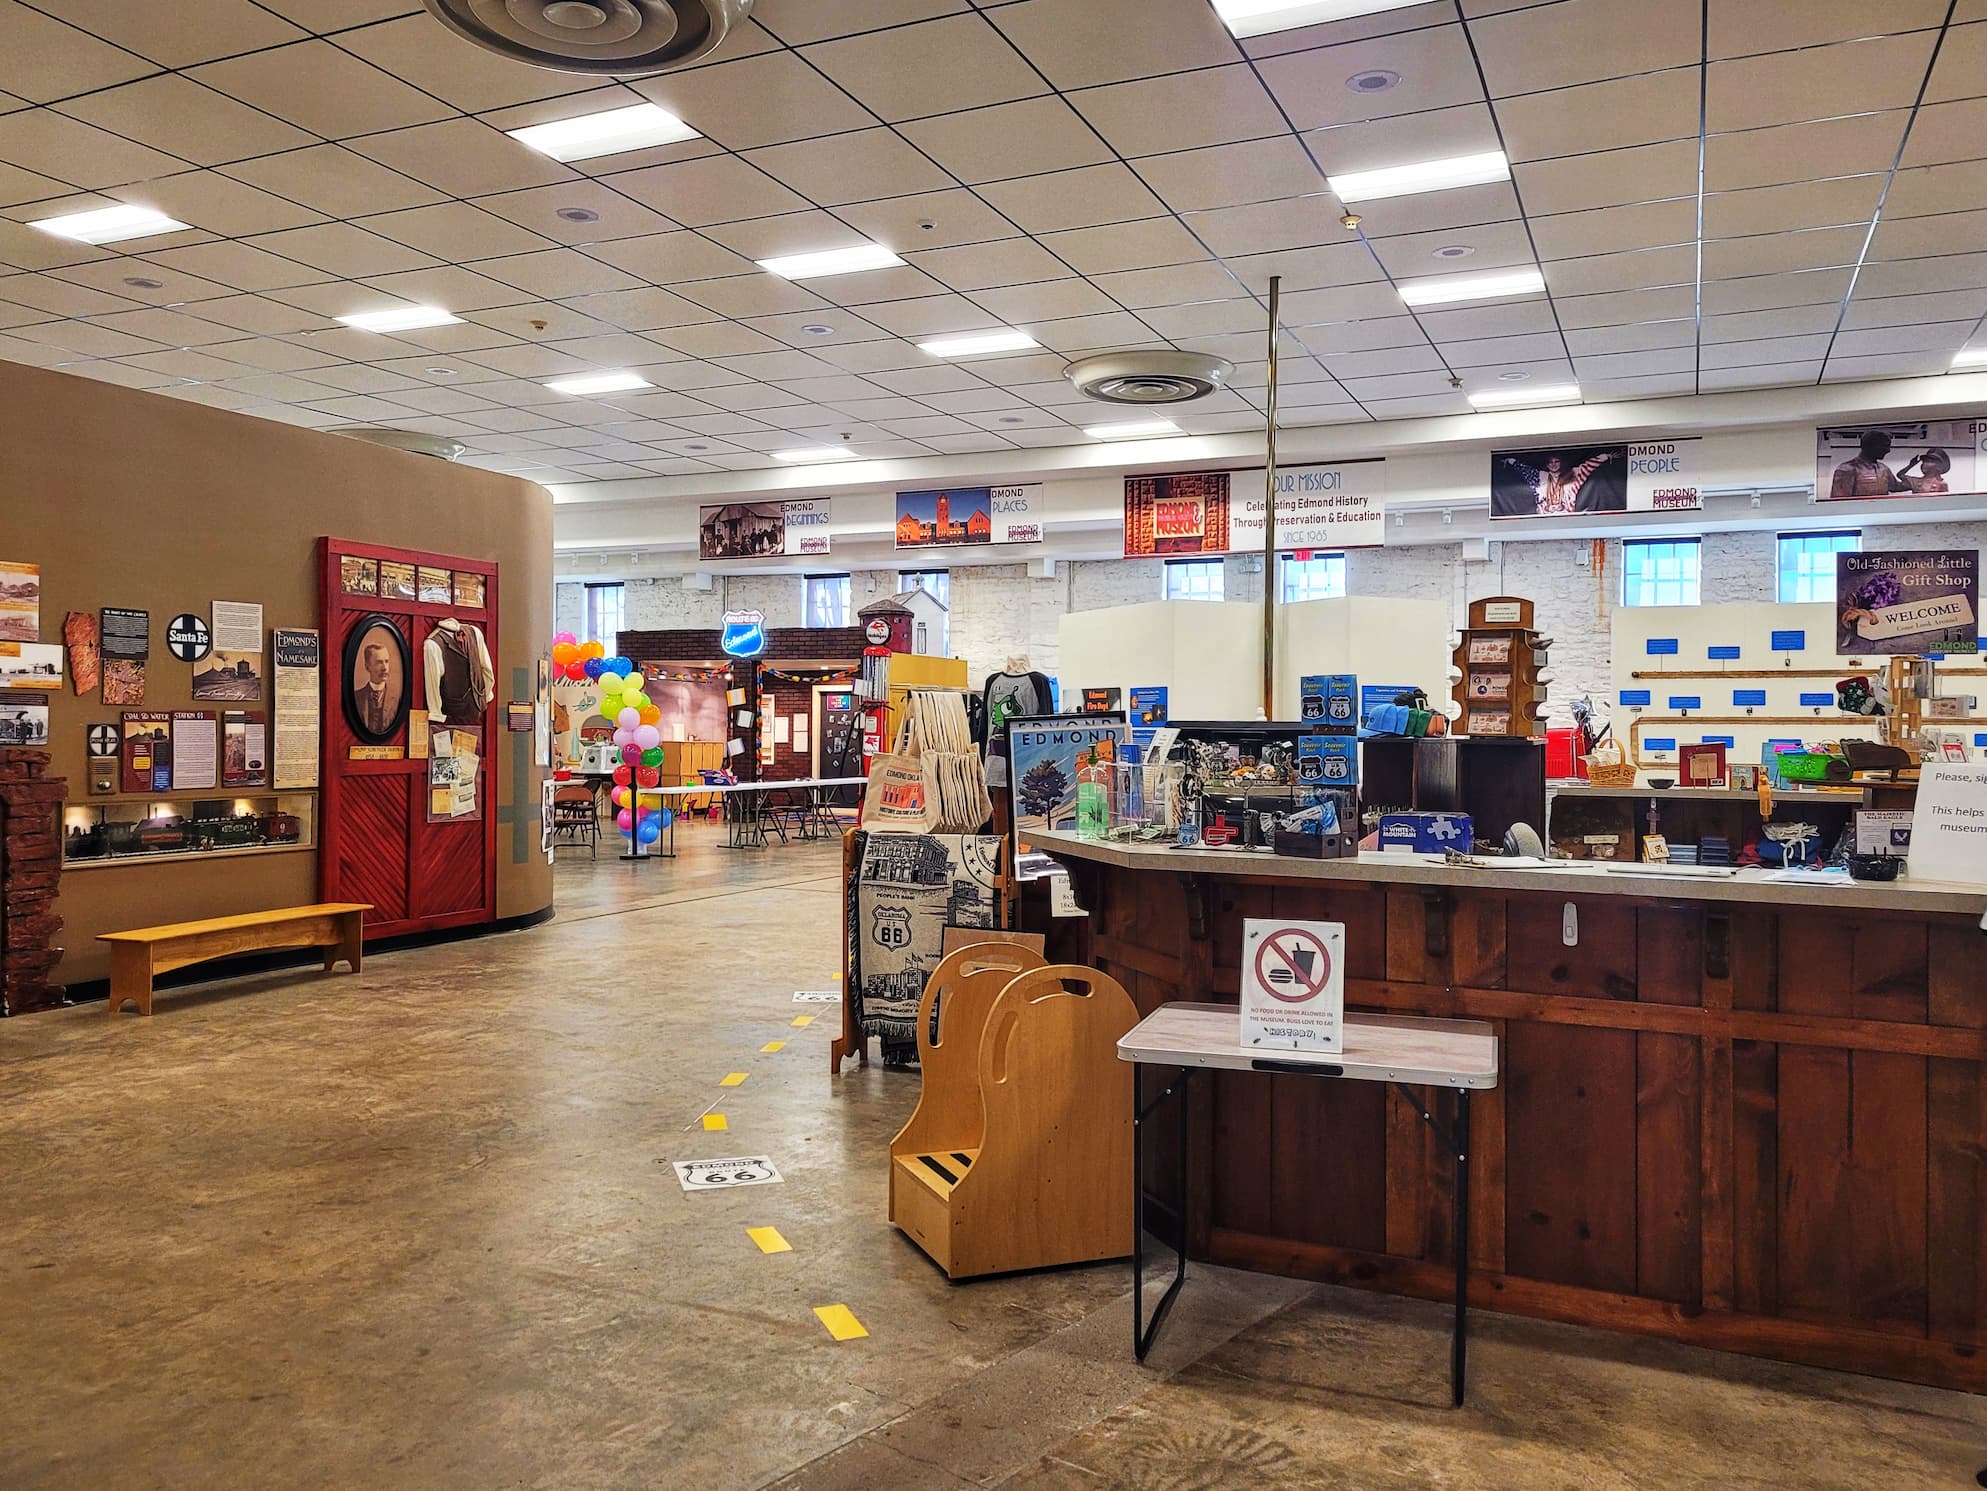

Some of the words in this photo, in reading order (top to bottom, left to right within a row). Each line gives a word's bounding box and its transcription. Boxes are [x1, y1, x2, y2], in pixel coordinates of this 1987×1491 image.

[1629, 444, 1675, 456] DMOND
[1631, 458, 1680, 475] PEOPLE
[1298, 472, 1341, 493] MISSION
[991, 488, 1024, 499] DMOND
[1653, 488, 1697, 498] EDMOND
[780, 503, 814, 513] EDMOND
[993, 500, 1028, 512] PLACES
[1246, 501, 1296, 512] Celeating
[1298, 497, 1334, 508] Edmond
[1335, 496, 1369, 507] History
[1653, 498, 1697, 508] MUSEUM
[1273, 513, 1327, 526] reservation
[1328, 513, 1335, 523] &
[1337, 510, 1381, 523] Education
[1283, 531, 1304, 543] SINCE
[1306, 530, 1328, 542] 1965
[1846, 557, 1934, 570] Old-Fashioned
[1937, 555, 1972, 569] Little
[1902, 574, 1932, 586] Gift
[1935, 574, 1971, 589] Shop
[1885, 602, 1961, 625] WELCOME
[169, 630, 197, 643] Santa
[197, 631, 209, 644] Fe
[277, 633, 317, 648] EDMOND'S
[1929, 642, 1977, 650] EDMOND
[277, 651, 318, 665] NAMESAKE
[1307, 708, 1320, 717] 66
[1335, 708, 1346, 717] 66
[1023, 730, 1116, 745] EDMOND
[1305, 768, 1318, 777] 66
[1329, 768, 1342, 777] 66
[1935, 772, 1972, 783] Please,
[1931, 806, 1953, 815] This
[1955, 807, 1985, 817] helps
[1940, 824, 1987, 833] museum
[1182, 835, 1195, 843] 66
[881, 927, 903, 943] 66
[705, 1171, 757, 1183] 66
